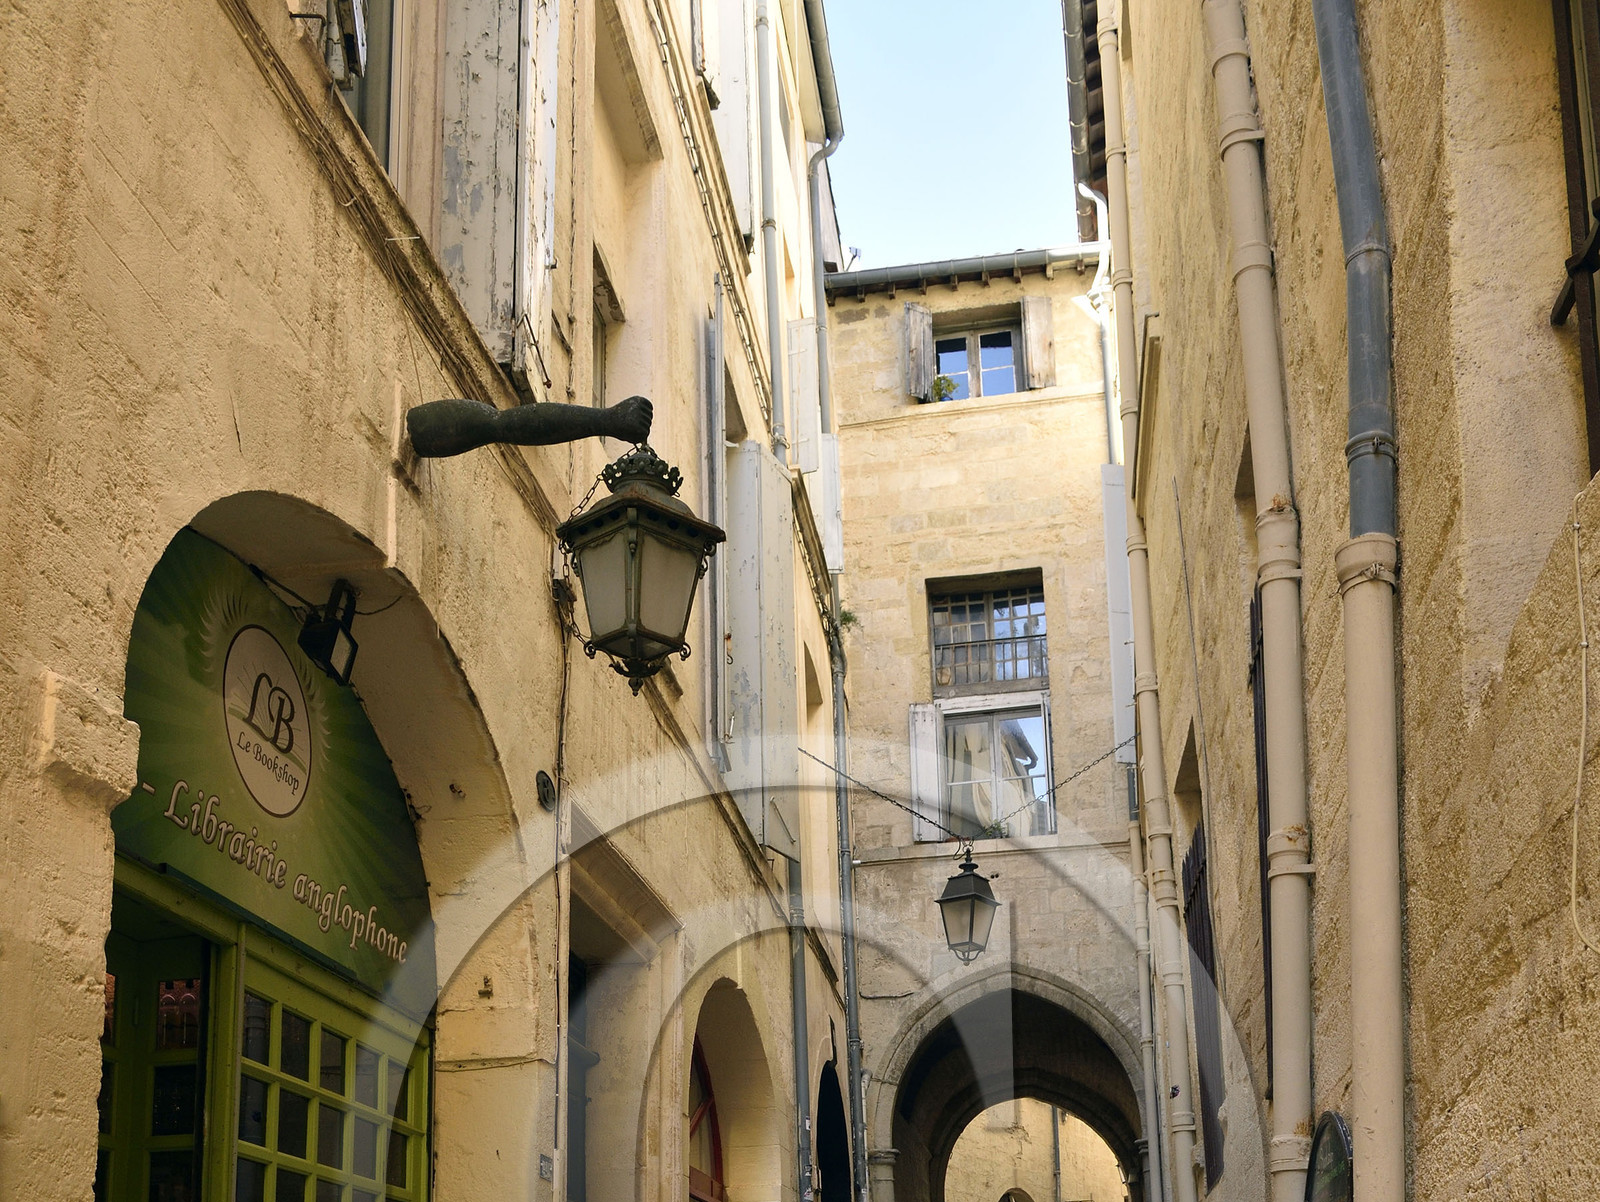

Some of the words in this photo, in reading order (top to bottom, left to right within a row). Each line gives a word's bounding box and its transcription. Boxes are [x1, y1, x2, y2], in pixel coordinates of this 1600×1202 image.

[236, 731, 251, 752] Le
[252, 743, 300, 796] Bookshop
[164, 779, 287, 890] Librairie
[293, 872, 409, 965] anglophone
